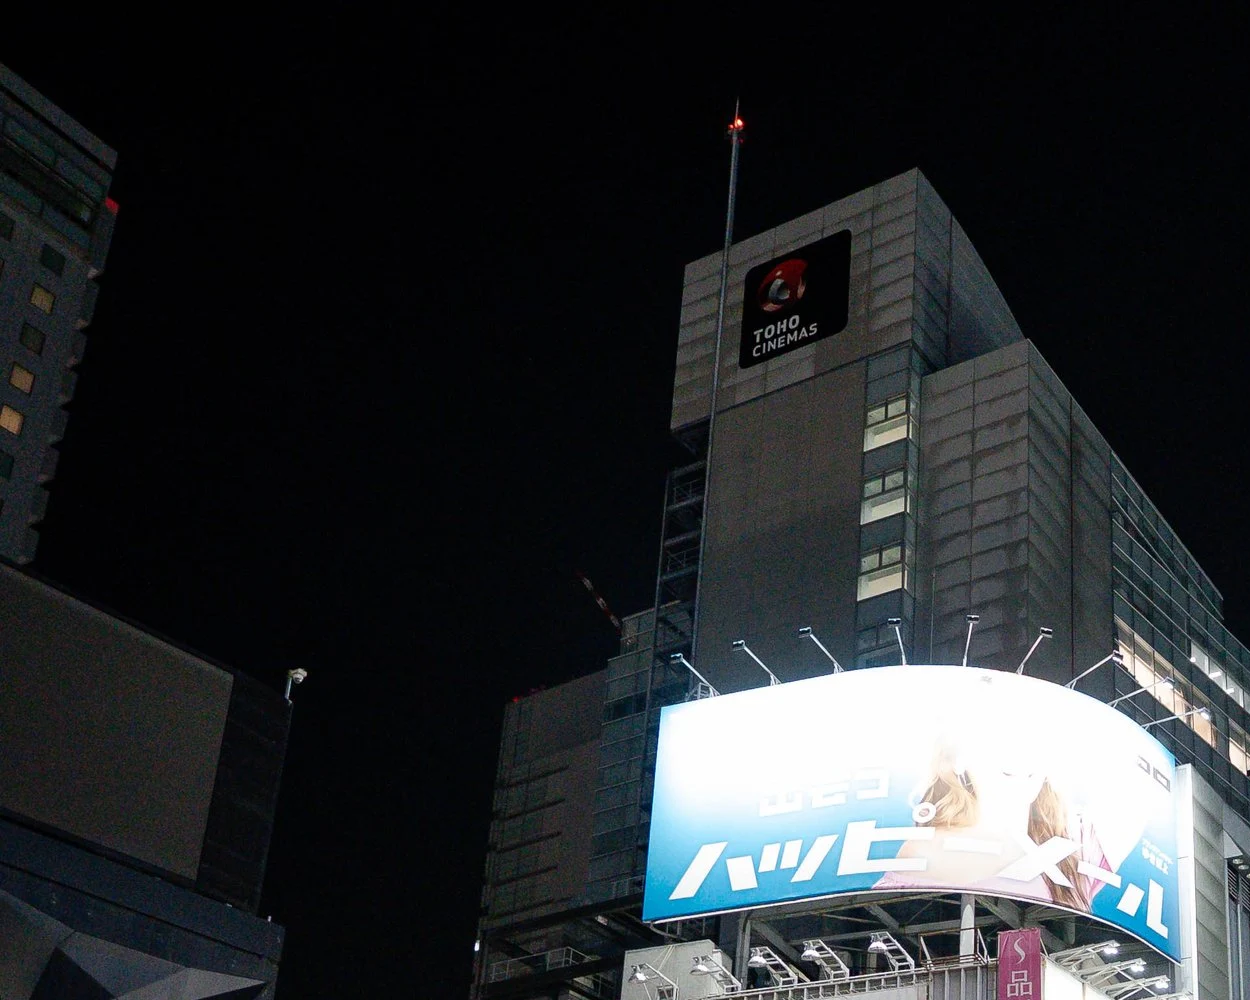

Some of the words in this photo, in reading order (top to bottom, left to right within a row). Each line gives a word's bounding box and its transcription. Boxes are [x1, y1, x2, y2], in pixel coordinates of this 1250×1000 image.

[752, 323, 818, 357] CINEMAS
[753, 315, 800, 343] TOHO
[669, 801, 1169, 939] ハッピーメール
